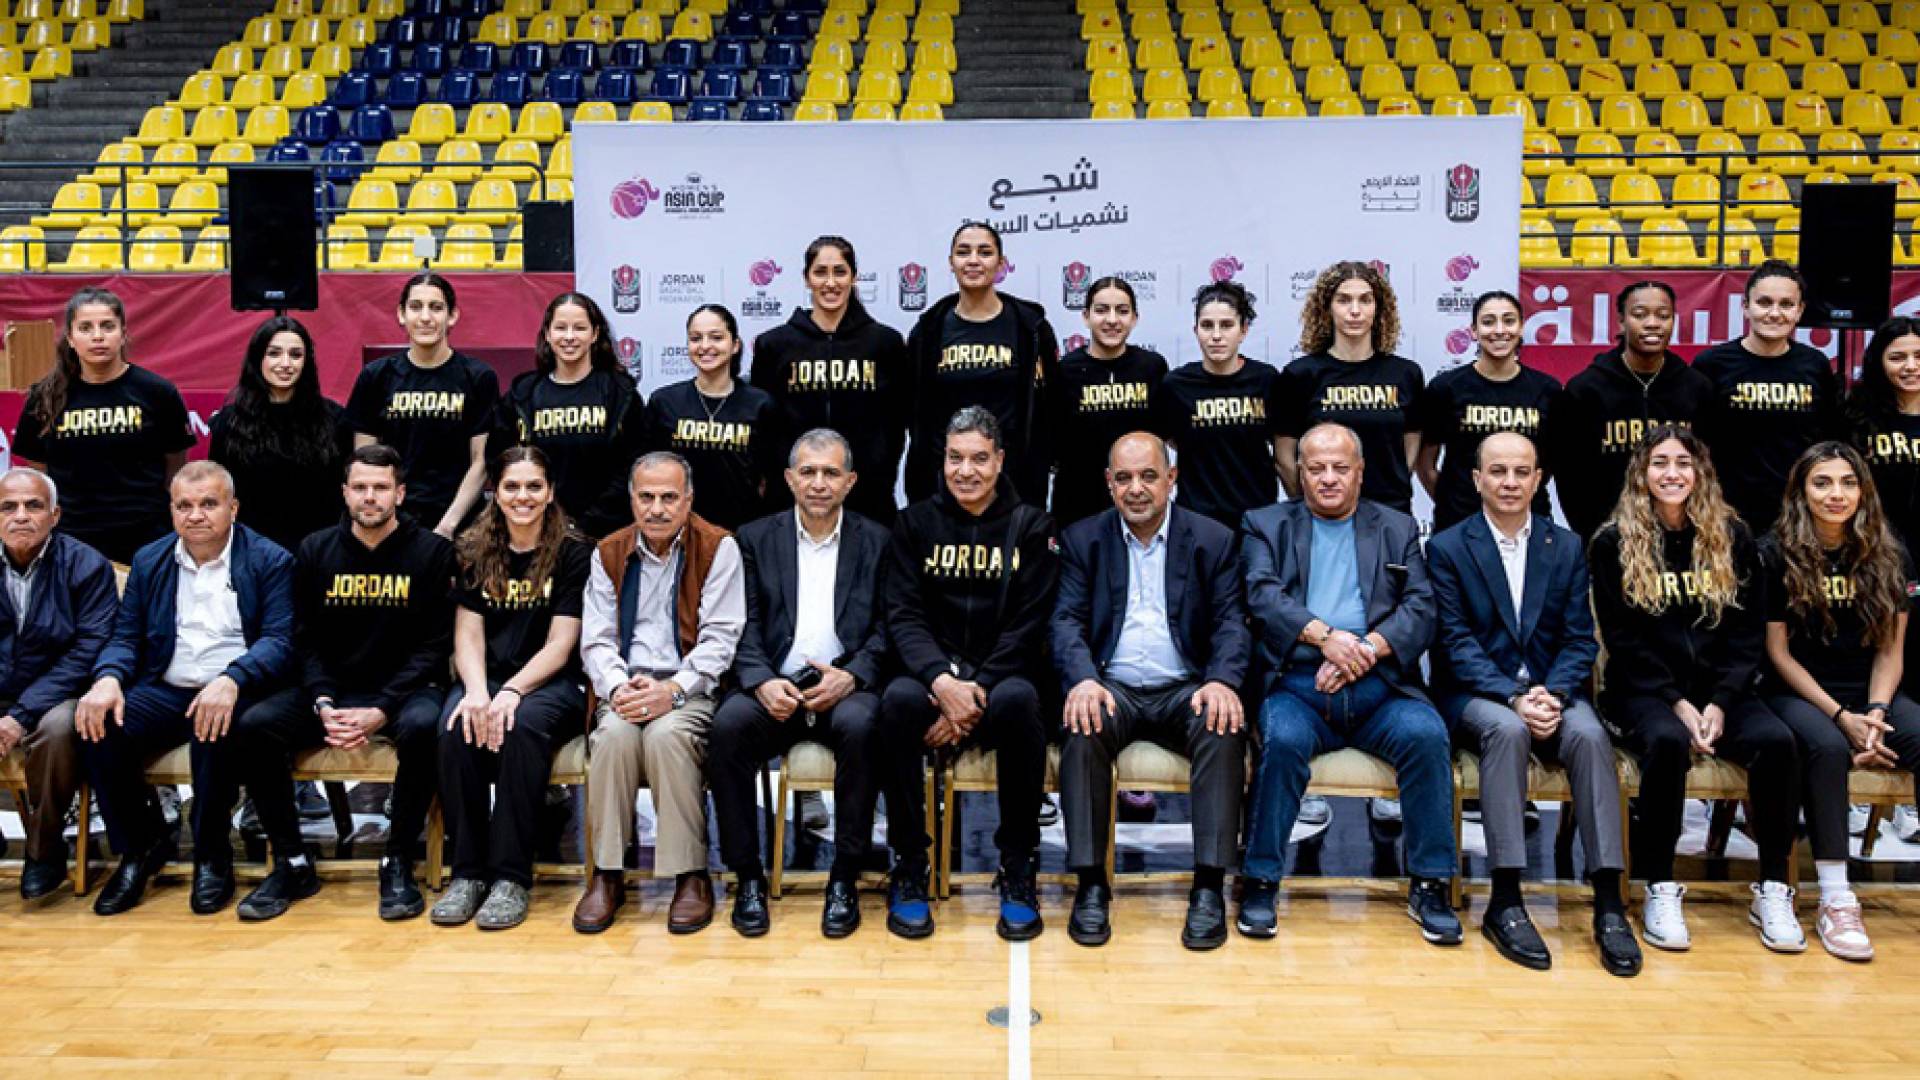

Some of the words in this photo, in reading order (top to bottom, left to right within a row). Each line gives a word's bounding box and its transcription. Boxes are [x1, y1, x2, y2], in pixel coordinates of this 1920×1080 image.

[988, 156, 1098, 210] شجع
[664, 191, 696, 207] ASIA
[698, 191, 725, 207] CUP
[1449, 201, 1478, 217] JBF
[1034, 202, 1128, 233] نشميات
[660, 274, 705, 285] JORDAN
[661, 346, 690, 356] JORD
[938, 345, 1012, 368] JORDAN
[788, 359, 876, 383] JORDAN
[388, 391, 464, 413] JORDAN
[1080, 383, 1147, 406] JORDAN
[1321, 385, 1398, 406] JORDAN
[1731, 383, 1812, 404] JORDAN
[56, 406, 142, 431] JORDAN
[534, 406, 607, 431] JORDAN
[1192, 397, 1265, 421] JORDAN
[1461, 404, 1539, 428] JORDAN
[673, 419, 750, 444] JORDAN
[326, 574, 411, 598] JORDAN
